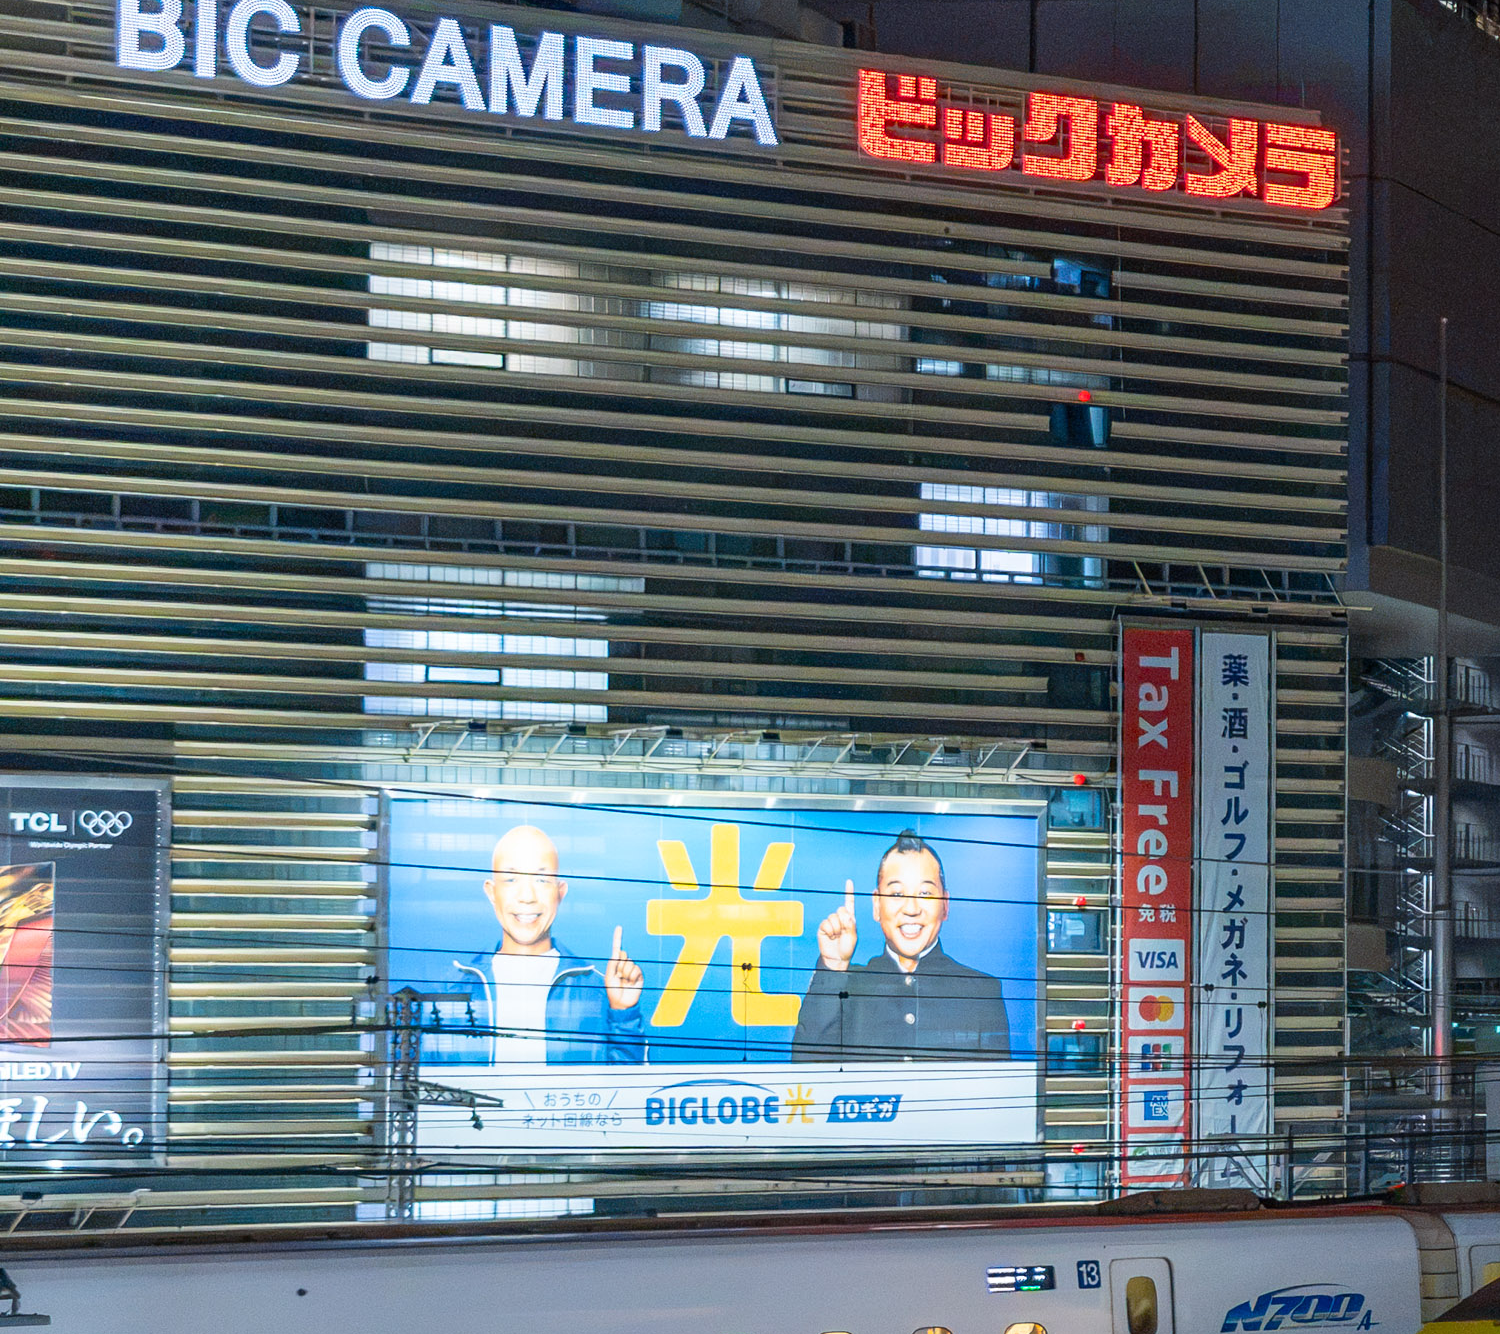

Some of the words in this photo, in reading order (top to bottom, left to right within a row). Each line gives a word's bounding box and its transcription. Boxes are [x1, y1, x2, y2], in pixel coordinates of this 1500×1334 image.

[335, 7, 779, 146] CAMERA
[857, 65, 1342, 210] ビックカメラ
[1137, 646, 1180, 750] Tax
[9, 811, 67, 833] TCL
[1136, 769, 1180, 896] Free
[1138, 903, 1177, 923] 免税
[645, 822, 805, 1028] 光
[1135, 950, 1179, 970] VISA
[54, 1062, 82, 1080] TV
[543, 1092, 601, 1107] おうちの
[645, 1095, 779, 1125] BIGLOBE
[835, 1099, 896, 1120] 10ギガ
[522, 1112, 623, 1128] ネット回線なら
[1078, 1263, 1099, 1286] 13
